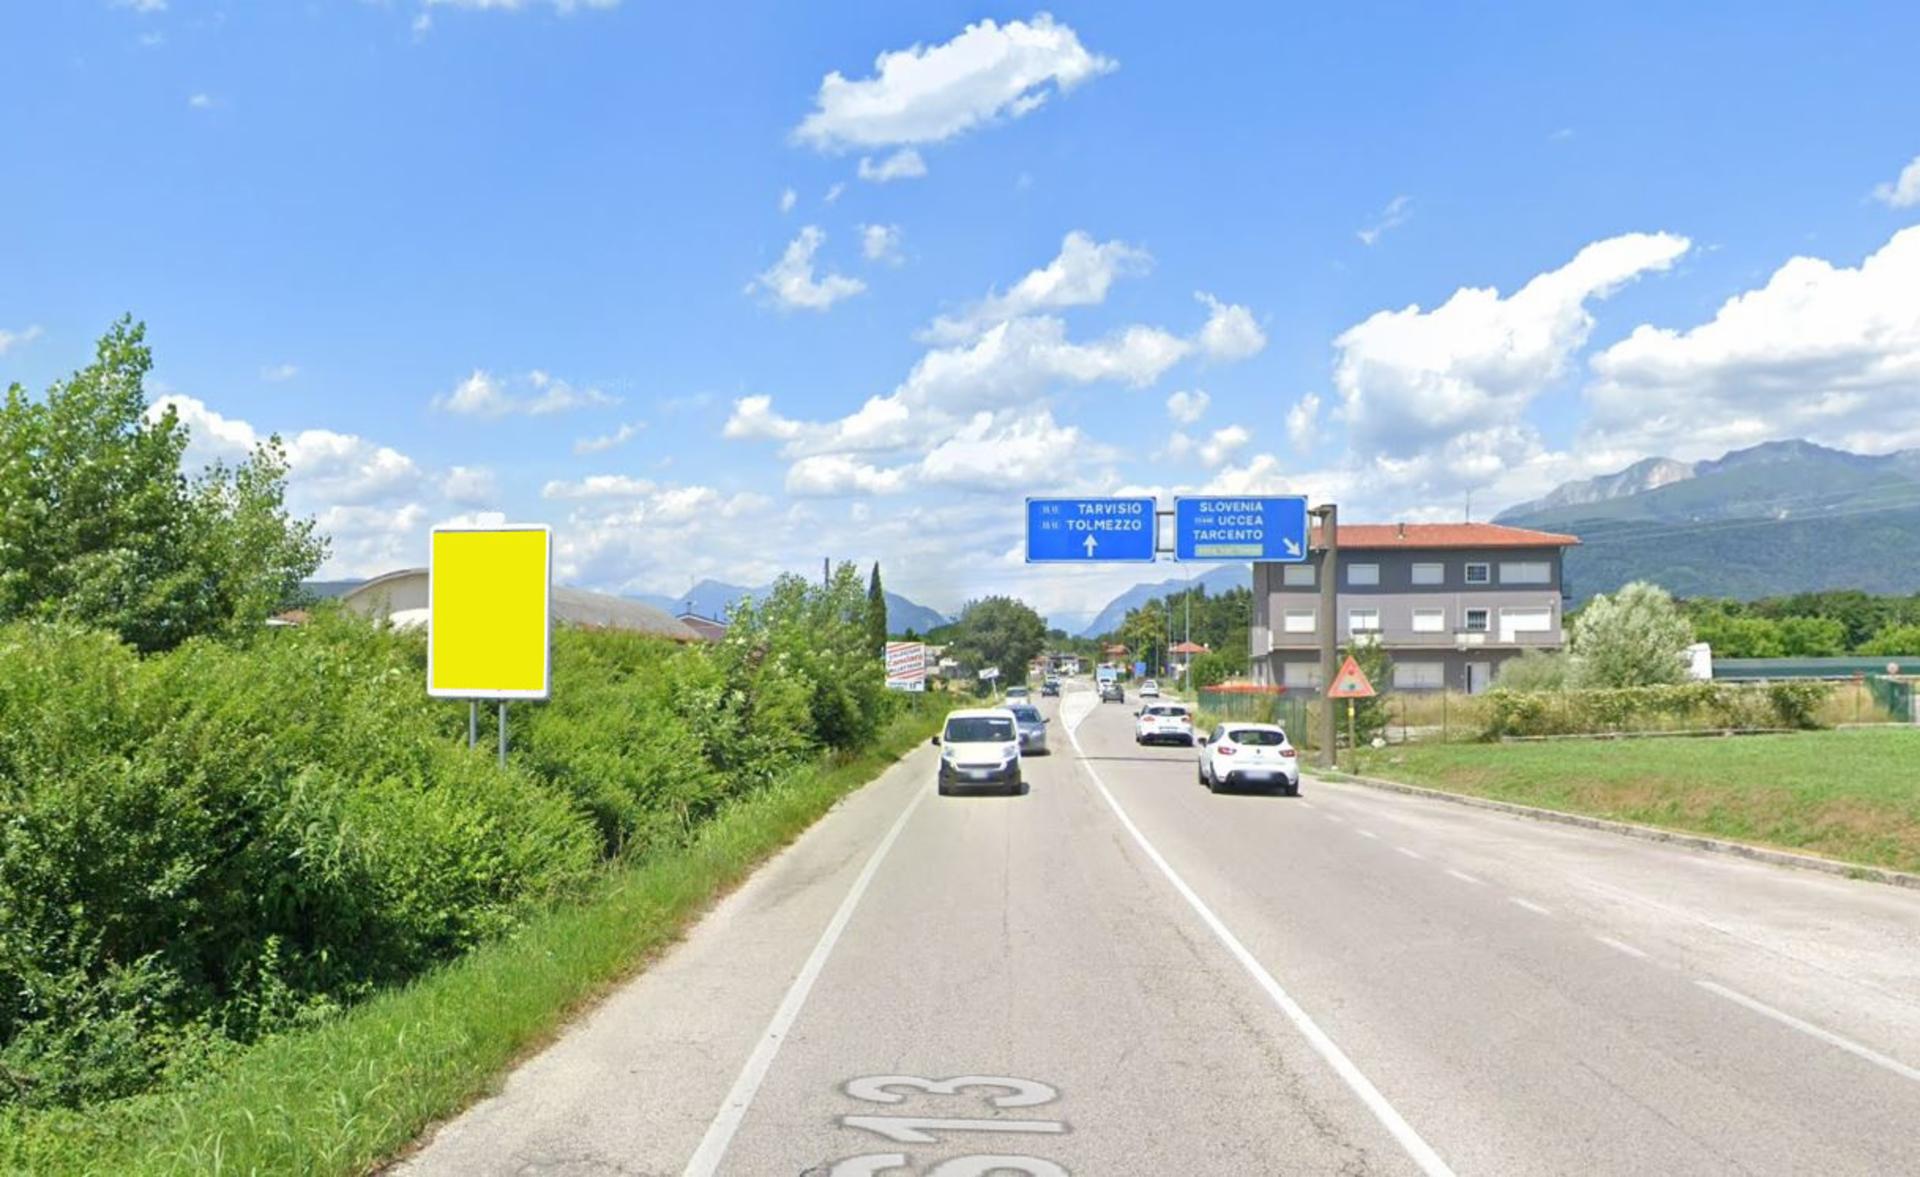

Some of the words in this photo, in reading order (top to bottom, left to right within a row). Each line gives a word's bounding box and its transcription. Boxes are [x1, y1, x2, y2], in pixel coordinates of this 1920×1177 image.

[1078, 503, 1142, 514] TARVISIO
[1200, 501, 1263, 512] SLOVENIA
[1066, 519, 1142, 531] TOLMEZZO
[1218, 515, 1263, 526] UCCEA
[1192, 529, 1263, 540] TARCENTO
